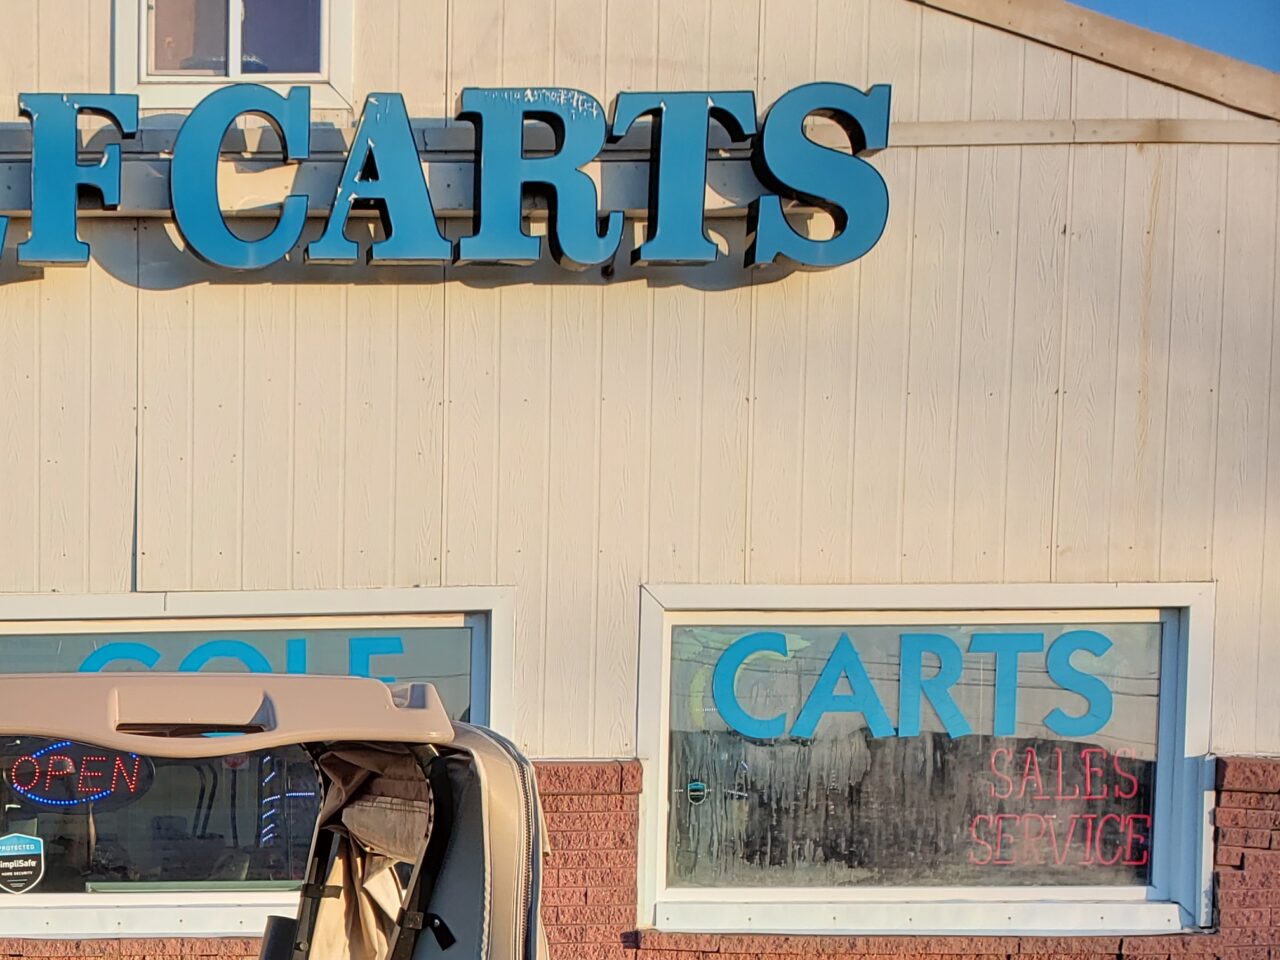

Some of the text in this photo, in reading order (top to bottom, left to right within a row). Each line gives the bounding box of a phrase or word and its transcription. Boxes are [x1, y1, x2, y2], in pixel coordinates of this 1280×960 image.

[712, 629, 1115, 739] CARTS
[10, 755, 141, 793] OPEN
[989, 747, 1139, 801] SALES
[968, 813, 1152, 867] SERVICE
